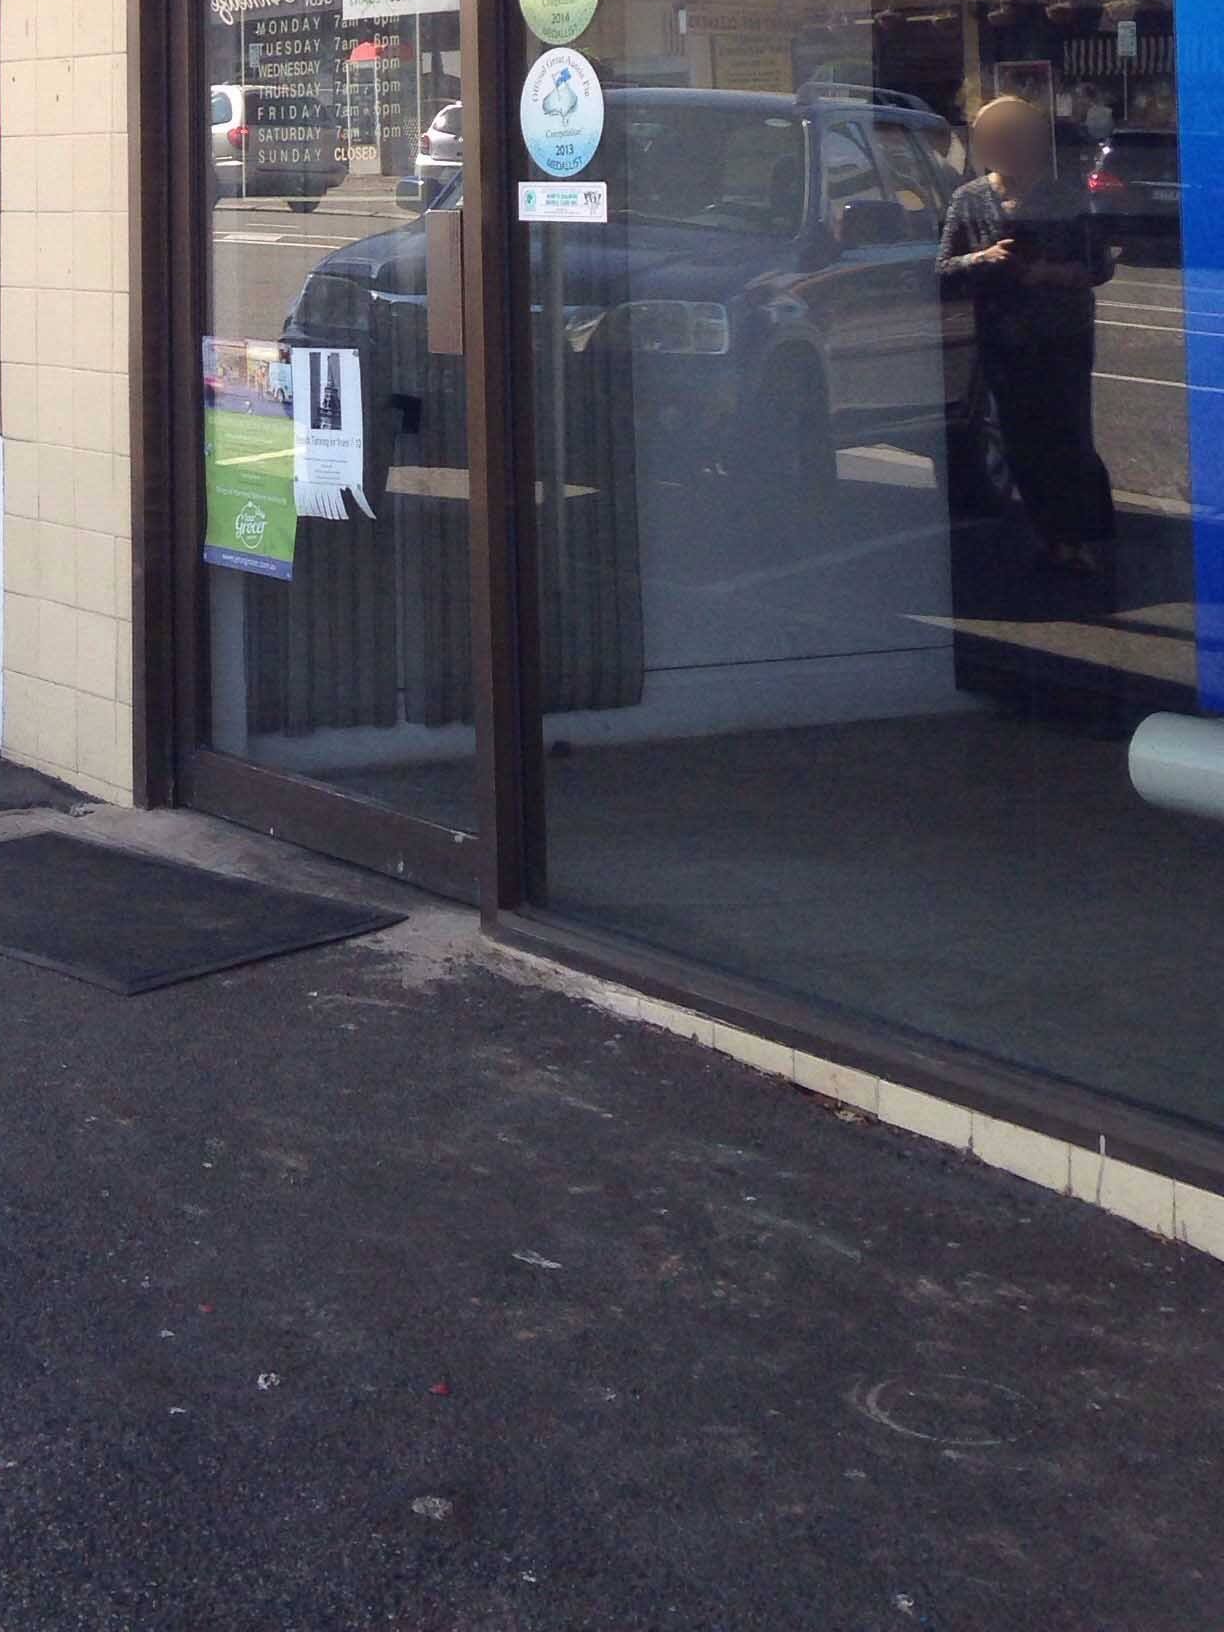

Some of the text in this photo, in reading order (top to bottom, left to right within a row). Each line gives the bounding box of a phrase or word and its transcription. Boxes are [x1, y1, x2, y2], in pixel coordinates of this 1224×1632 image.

[256, 18, 321, 36] MONDAY
[334, 15, 359, 28] 7am
[259, 39, 321, 56] TUESDAY
[334, 37, 359, 50] 7am
[258, 60, 321, 78] WEDNESDAY
[334, 59, 359, 72] 7am
[259, 82, 321, 99] THURSDAY
[334, 81, 360, 95] 7am
[258, 104, 321, 120] FRIDAY
[334, 103, 360, 117] 7am
[258, 127, 321, 142] SATURDAY
[335, 126, 360, 139] 7am
[258, 147, 376, 164] SUNDAY CLOSED
[556, 143, 574, 156] 2013
